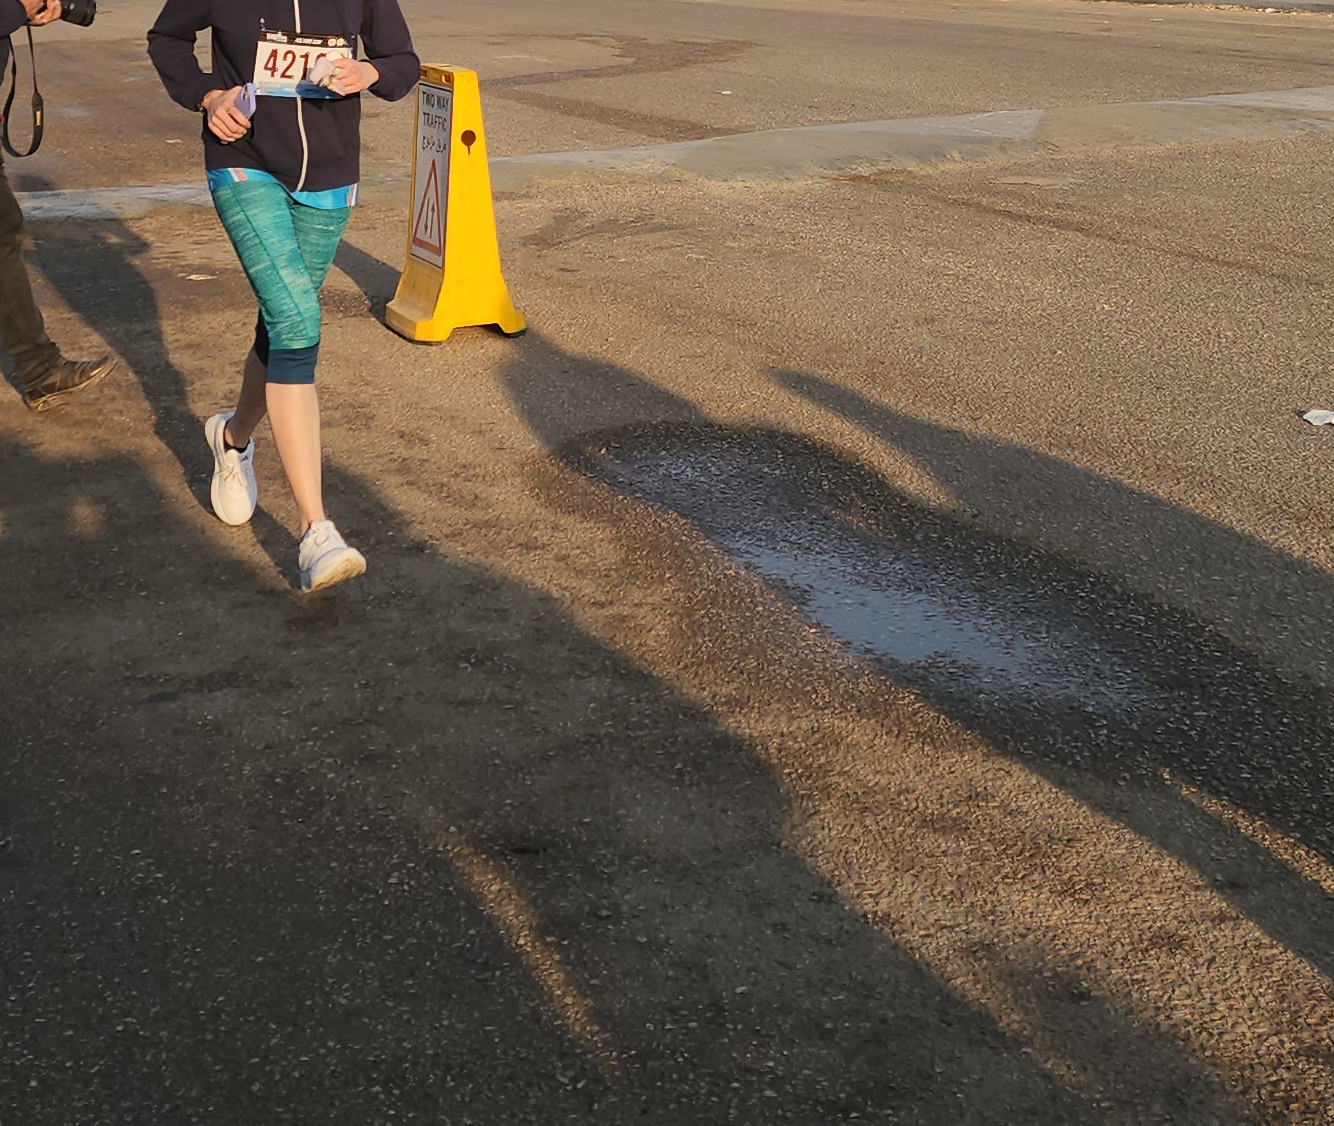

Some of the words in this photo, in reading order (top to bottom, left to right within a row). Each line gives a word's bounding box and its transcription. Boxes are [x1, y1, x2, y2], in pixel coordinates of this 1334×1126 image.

[263, 48, 329, 82] 421
[421, 90, 436, 109] TWO
[436, 94, 450, 112] WAY
[422, 111, 447, 133] TRAFFIC
